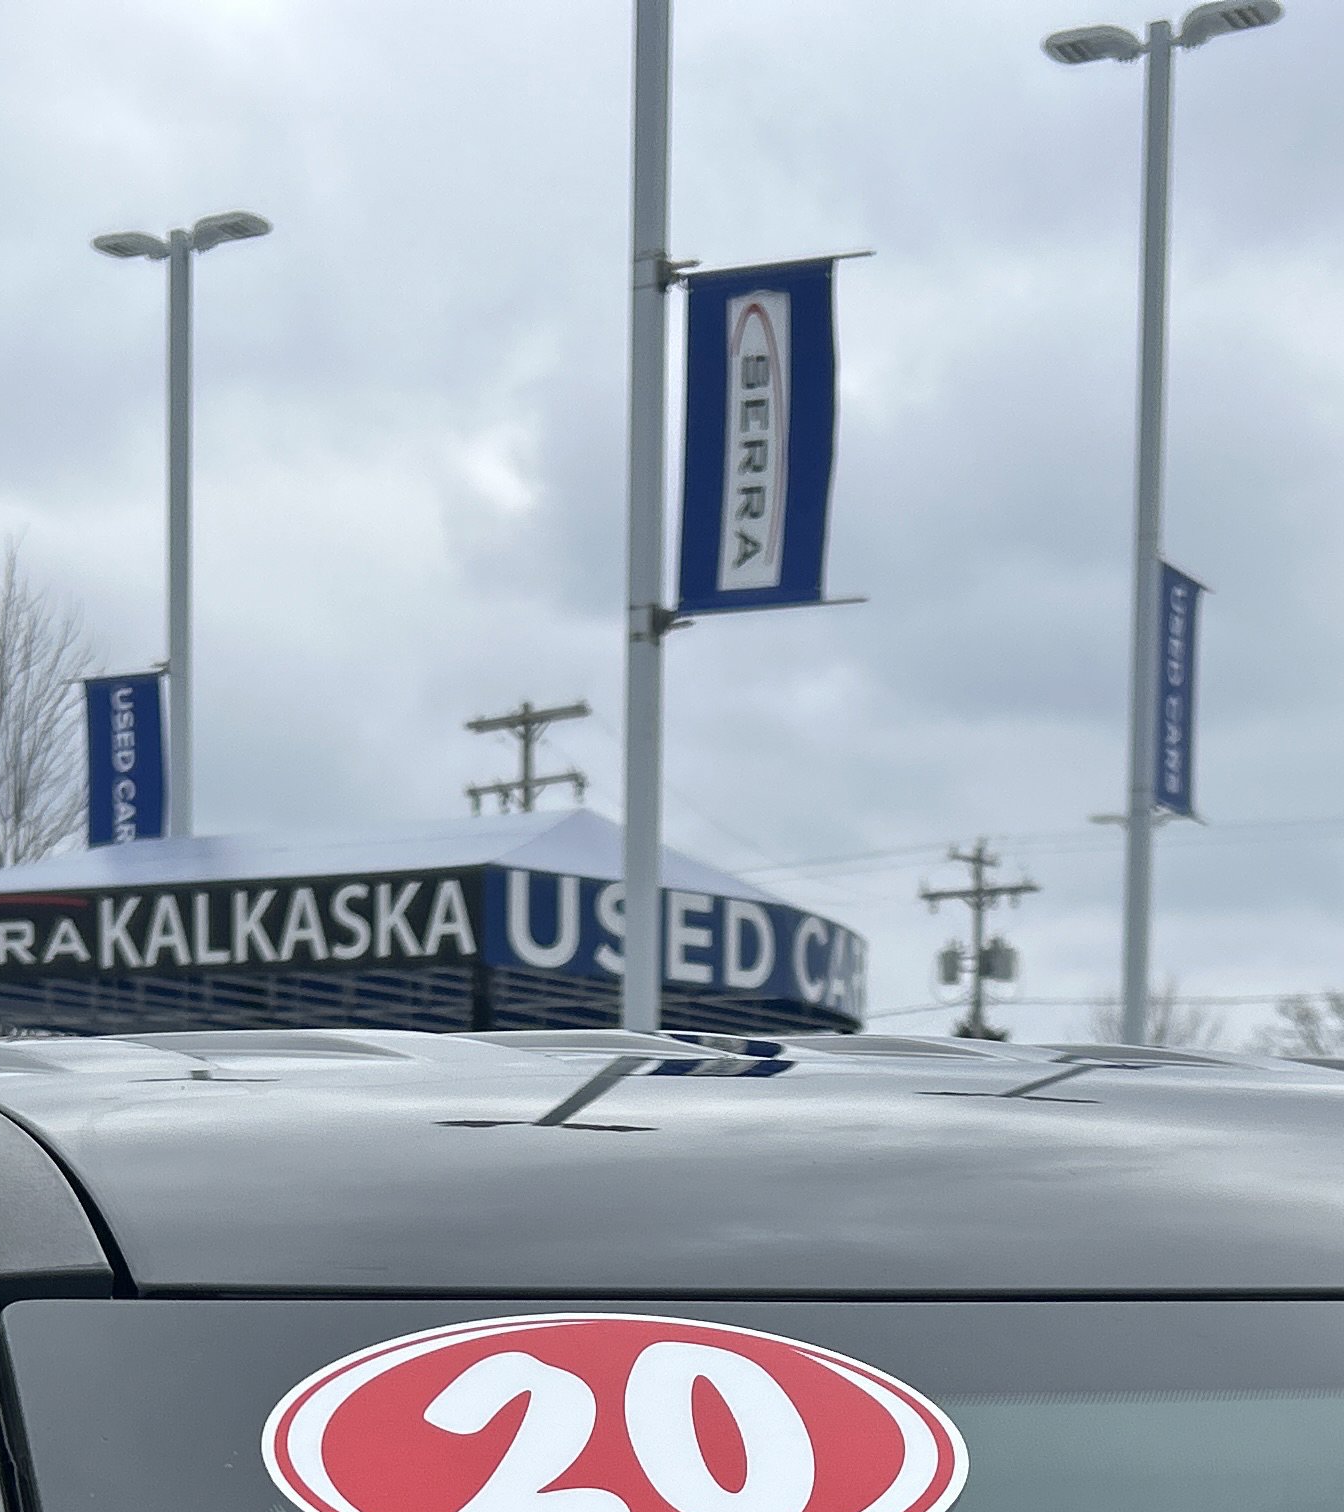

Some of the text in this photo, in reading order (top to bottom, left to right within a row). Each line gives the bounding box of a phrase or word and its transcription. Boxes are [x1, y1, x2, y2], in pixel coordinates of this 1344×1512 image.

[734, 354, 770, 568] SERRA
[112, 687, 136, 773] USED
[97, 878, 478, 970] KALKASKA
